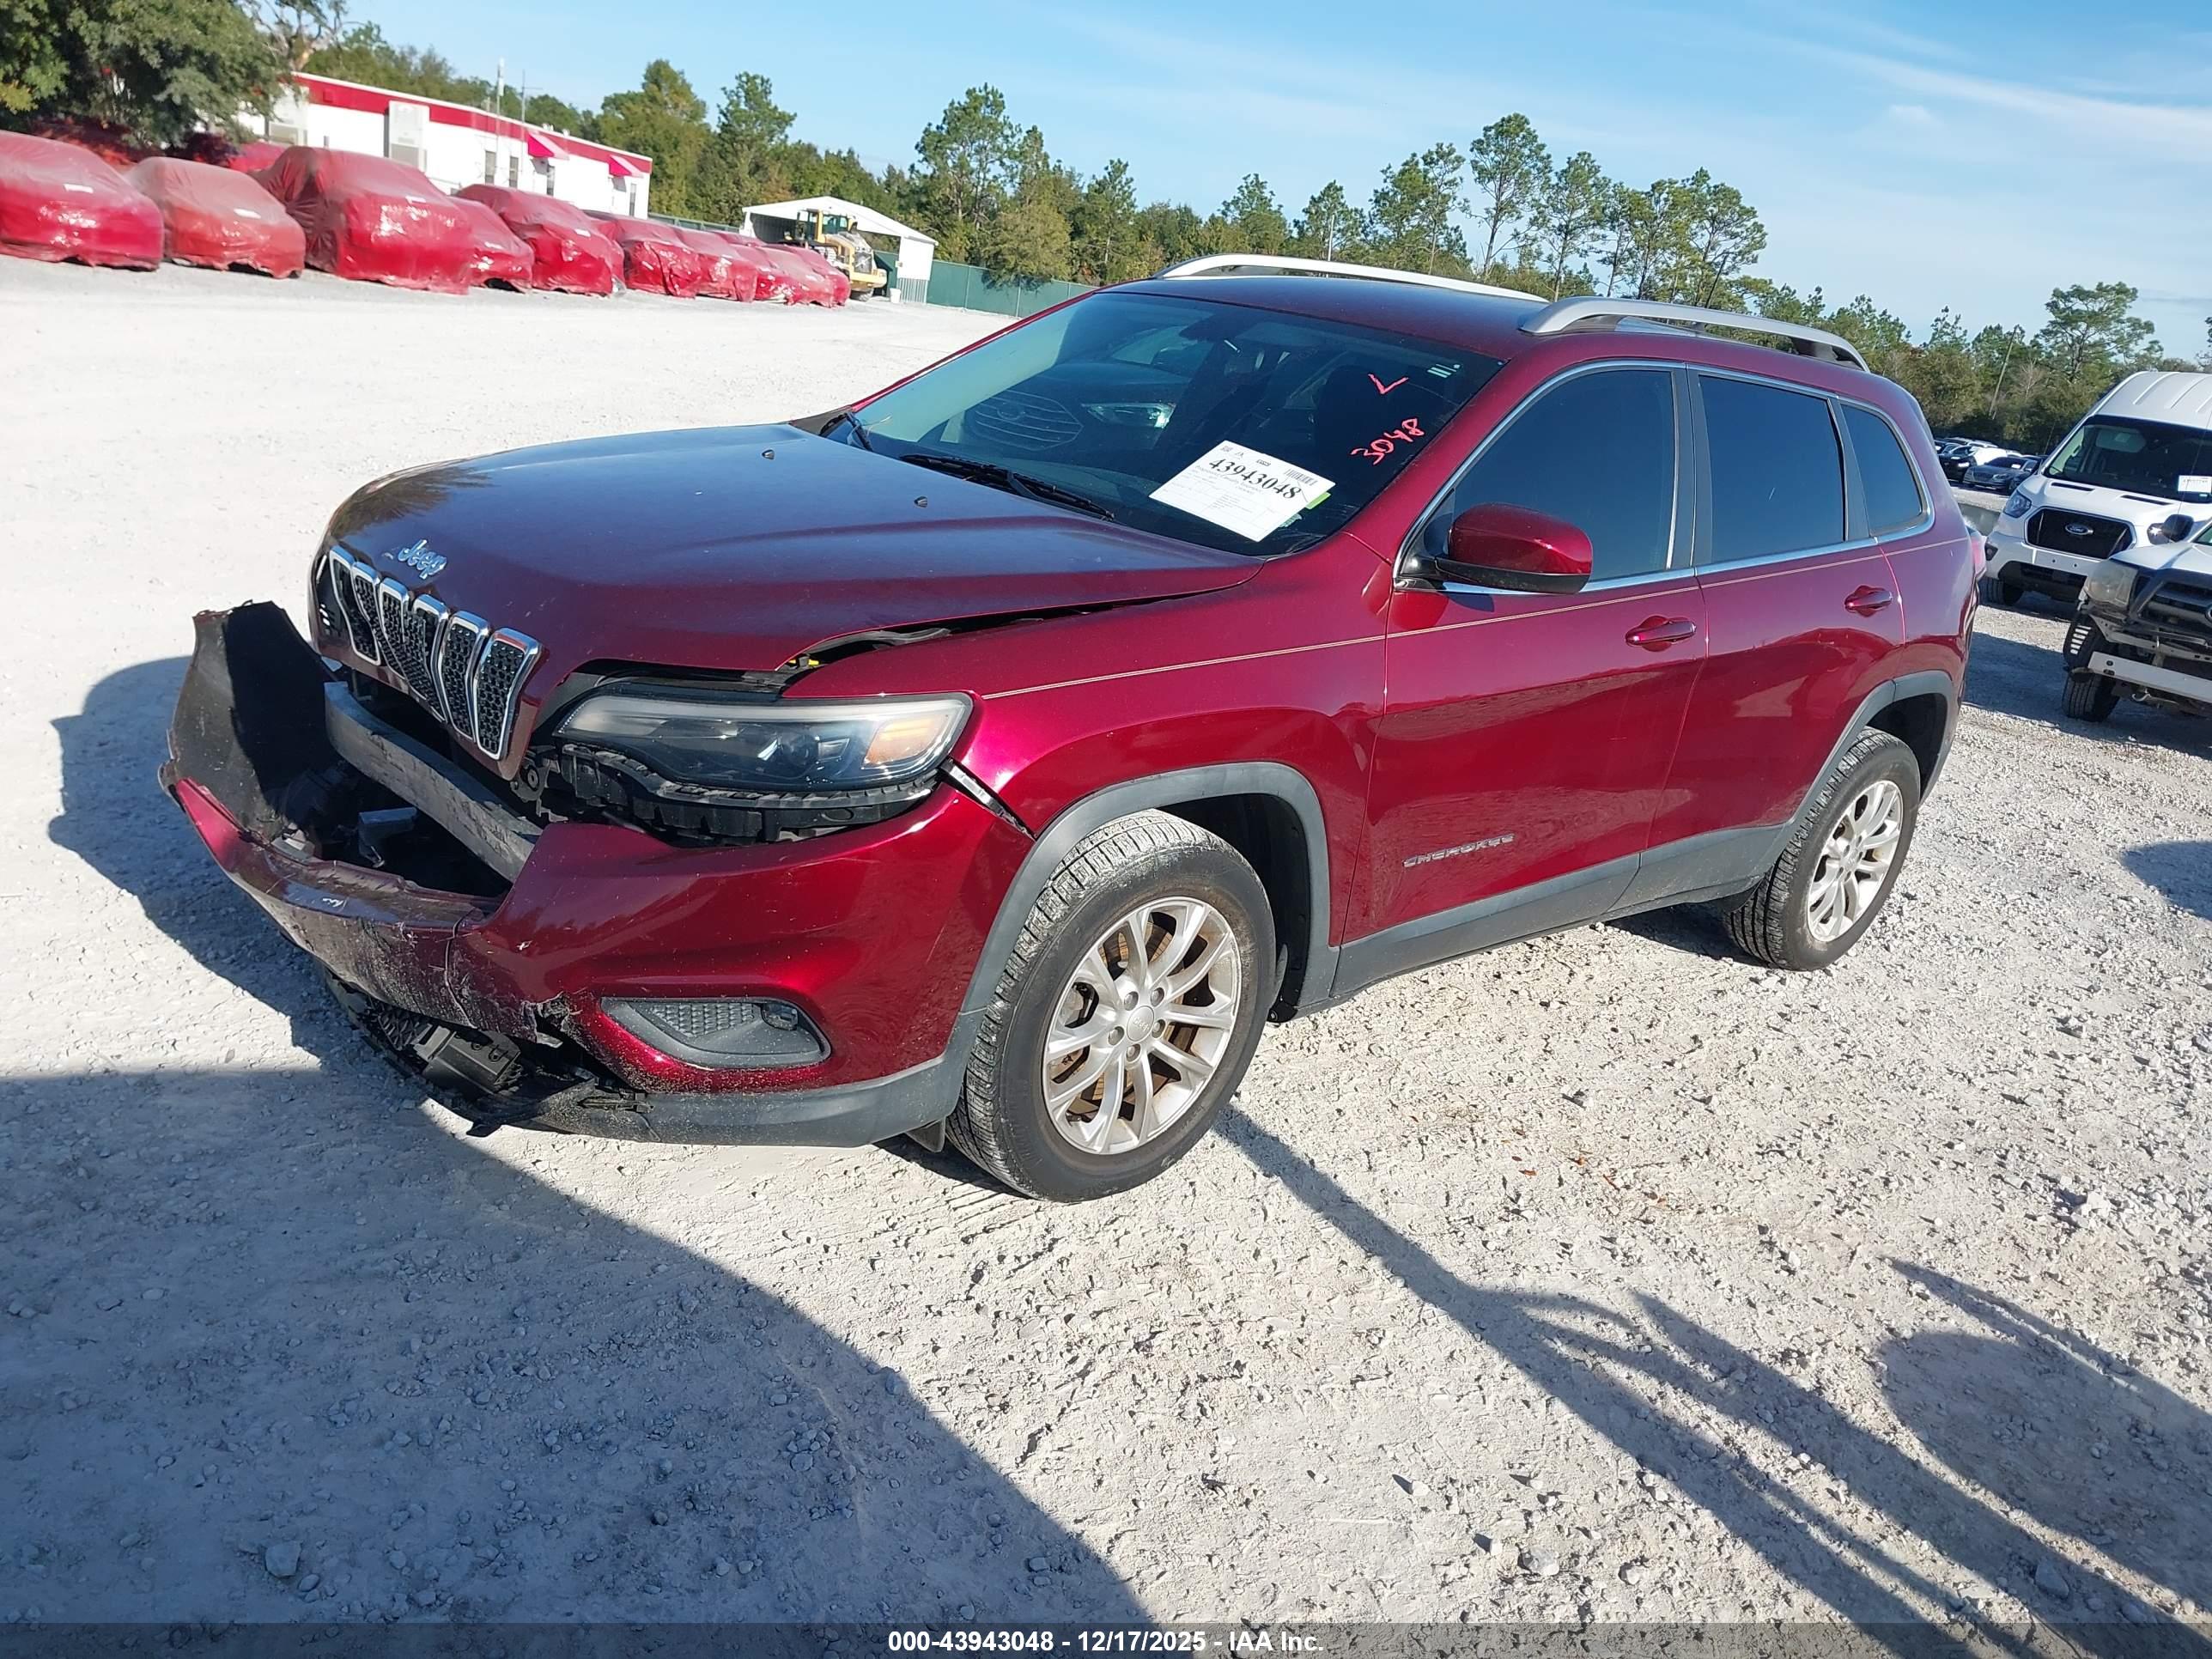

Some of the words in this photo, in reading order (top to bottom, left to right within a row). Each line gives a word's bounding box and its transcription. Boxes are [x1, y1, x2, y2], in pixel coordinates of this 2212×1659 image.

[1350, 418, 1425, 465] 3048
[1208, 458, 1302, 499] 43943048
[398, 539, 447, 580] Jeep
[1402, 833, 1515, 867] CHEROKEE
